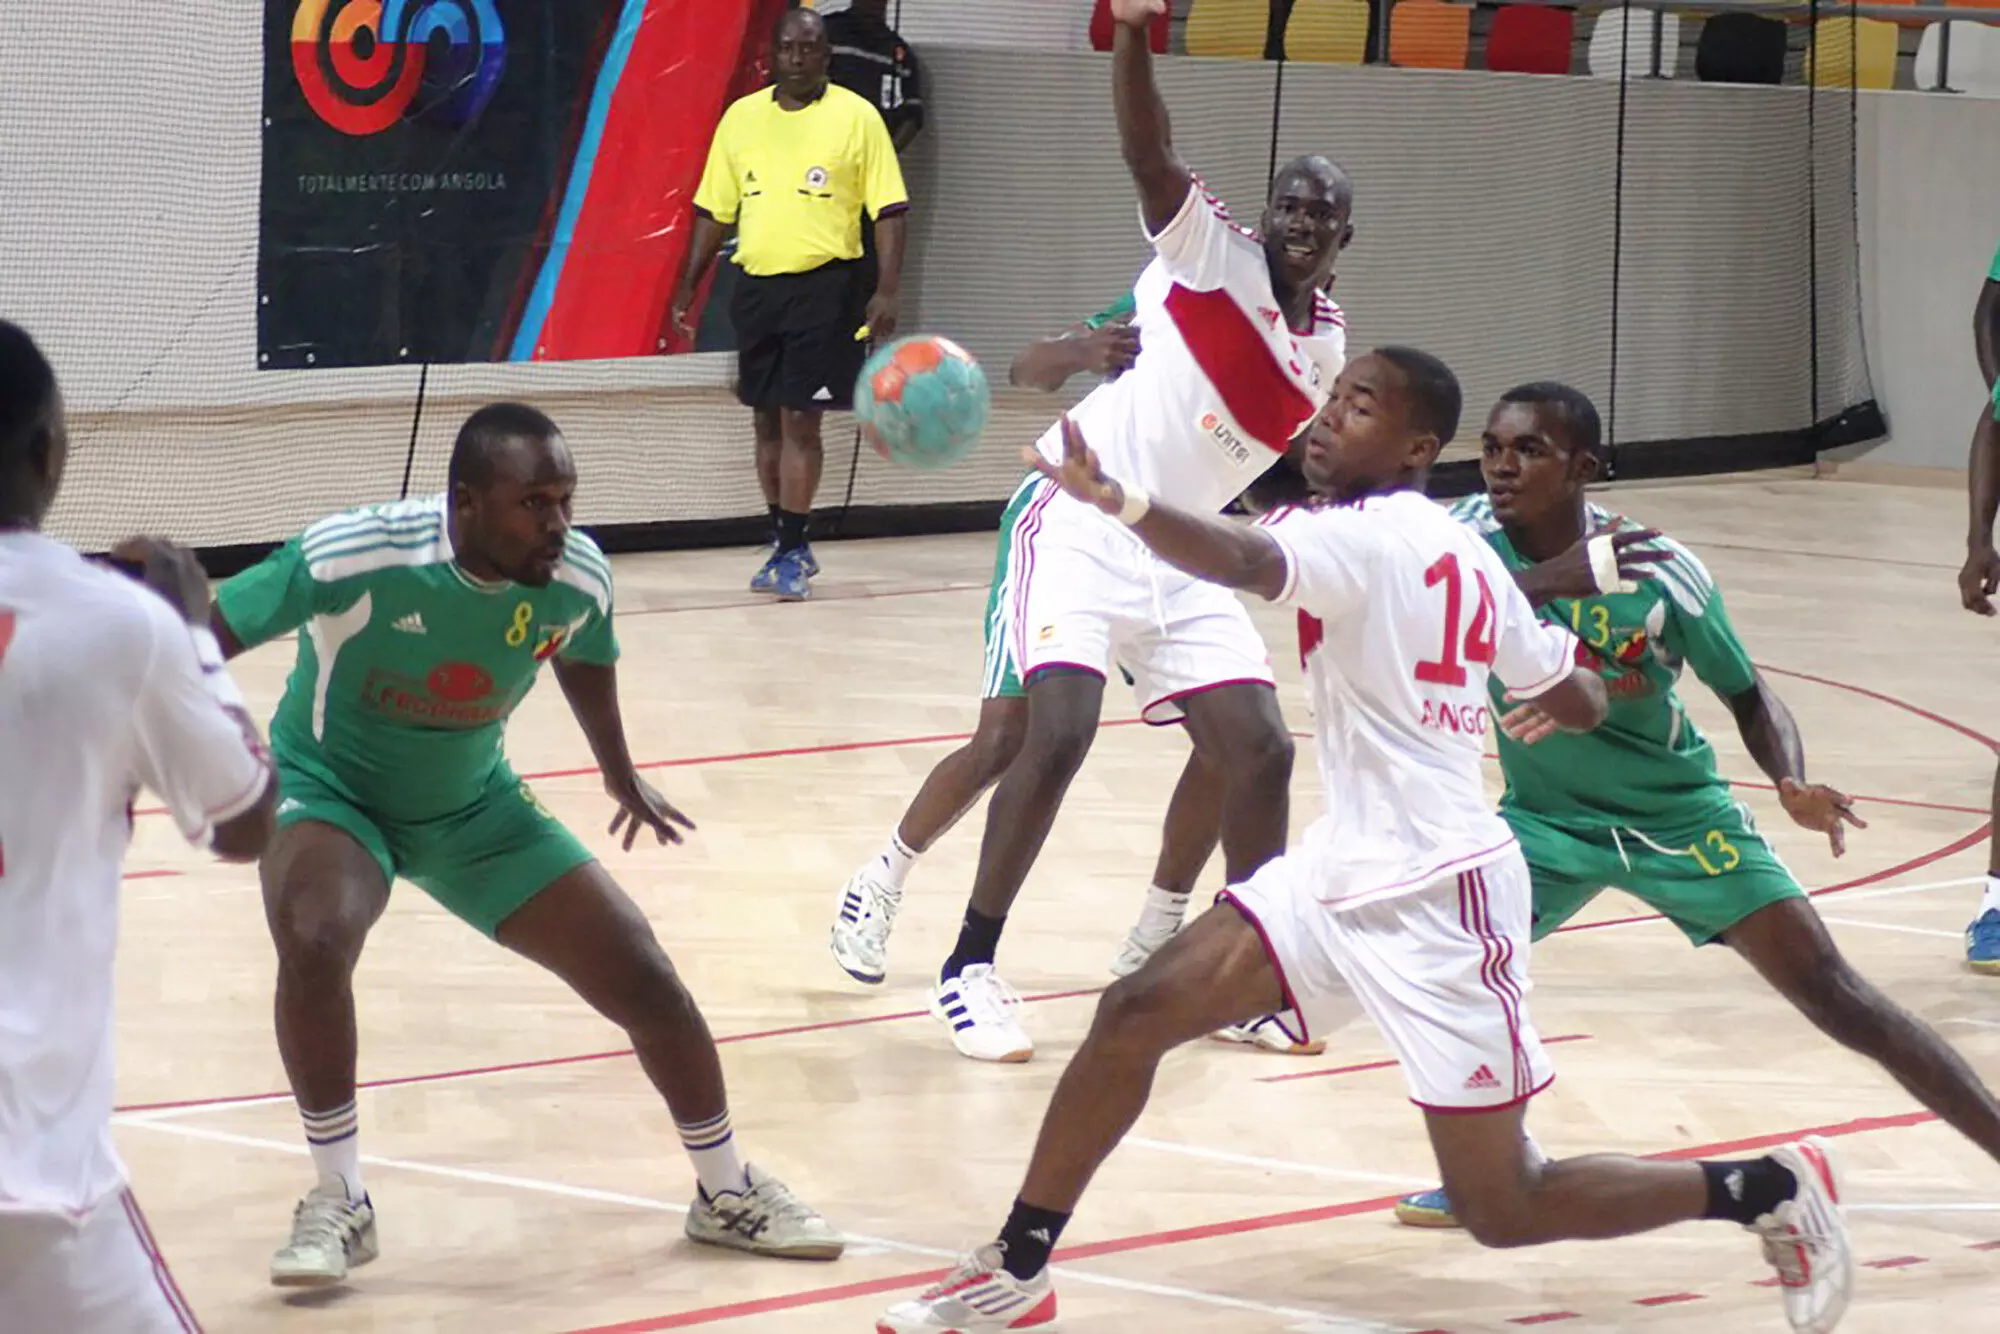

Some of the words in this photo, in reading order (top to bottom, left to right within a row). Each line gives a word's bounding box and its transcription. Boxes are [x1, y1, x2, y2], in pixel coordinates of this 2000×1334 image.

[297, 173, 398, 194] TOTALMENTE
[400, 172, 435, 191] COM
[439, 171, 507, 191] ANGOLA
[505, 601, 533, 646] 8
[1414, 551, 1498, 689] 14
[1569, 599, 1610, 648] 13
[1687, 829, 1740, 877] 13
